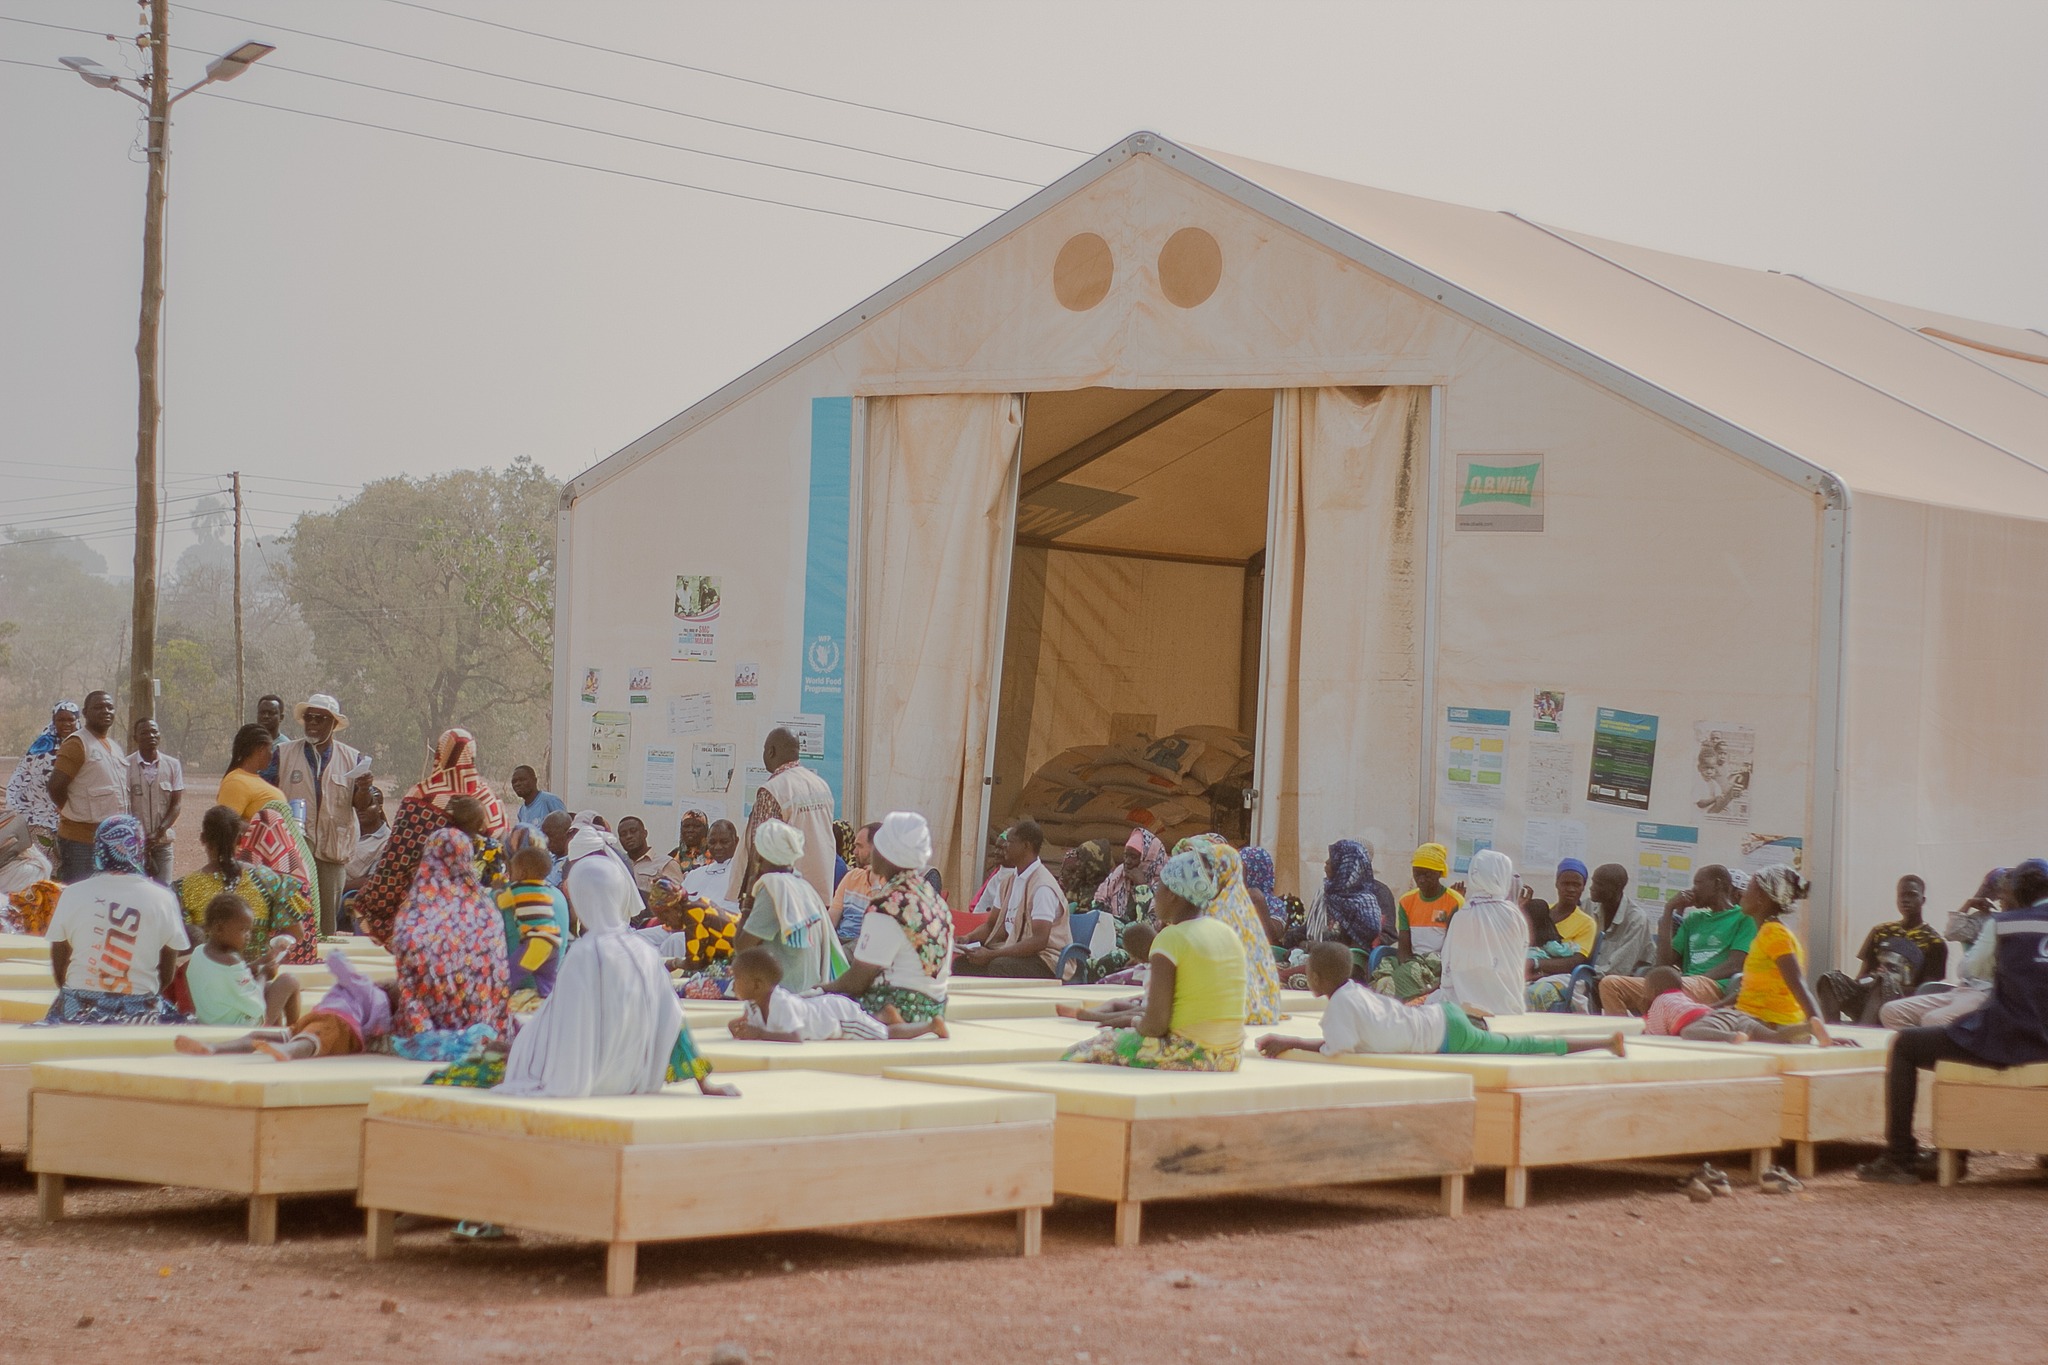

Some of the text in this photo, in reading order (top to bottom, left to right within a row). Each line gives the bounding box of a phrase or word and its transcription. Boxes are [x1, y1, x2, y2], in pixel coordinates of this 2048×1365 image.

[805, 677, 842, 685] World Food
[804, 685, 841, 694] Programme
[98, 901, 141, 994] SUNS
